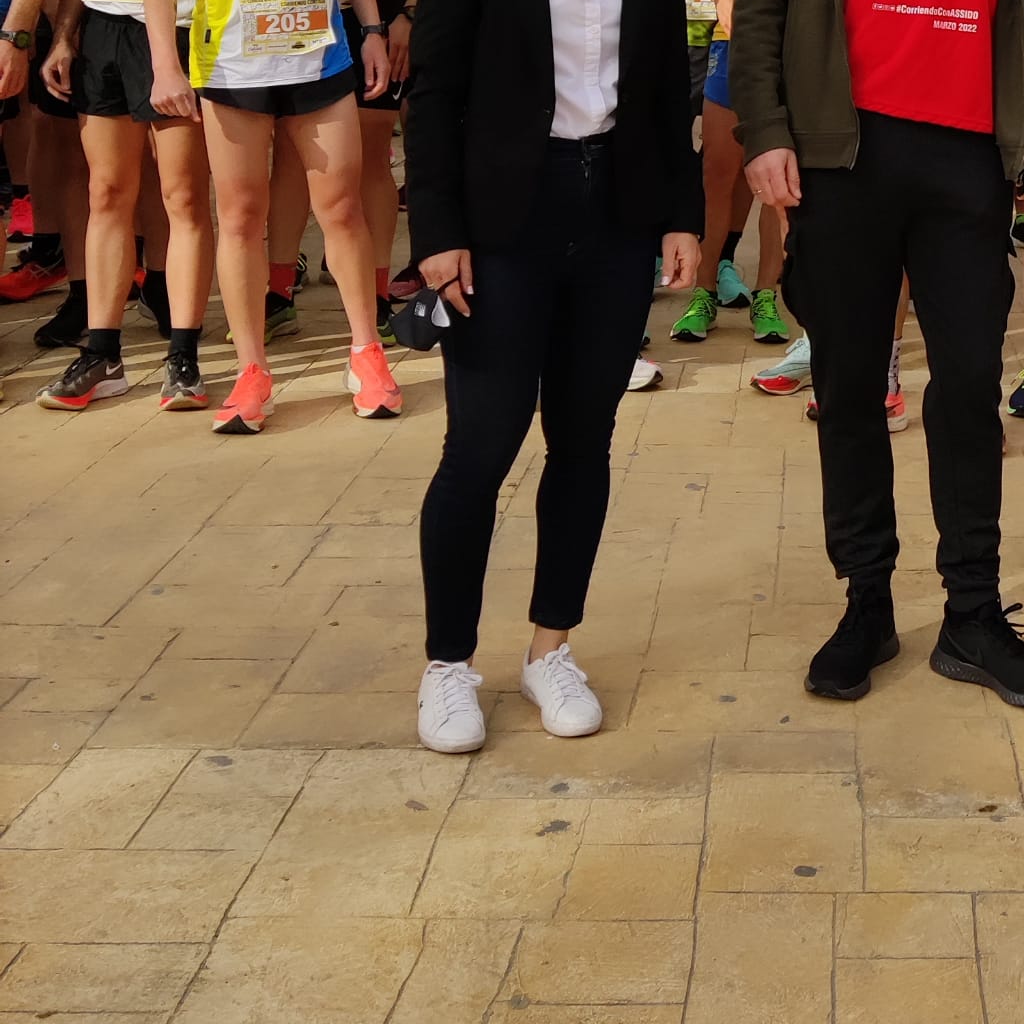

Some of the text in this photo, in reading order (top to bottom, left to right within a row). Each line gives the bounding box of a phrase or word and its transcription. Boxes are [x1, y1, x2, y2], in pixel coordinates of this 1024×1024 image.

[265, 11, 311, 34] 205
[932, 20, 978, 33] MARZO 2022
